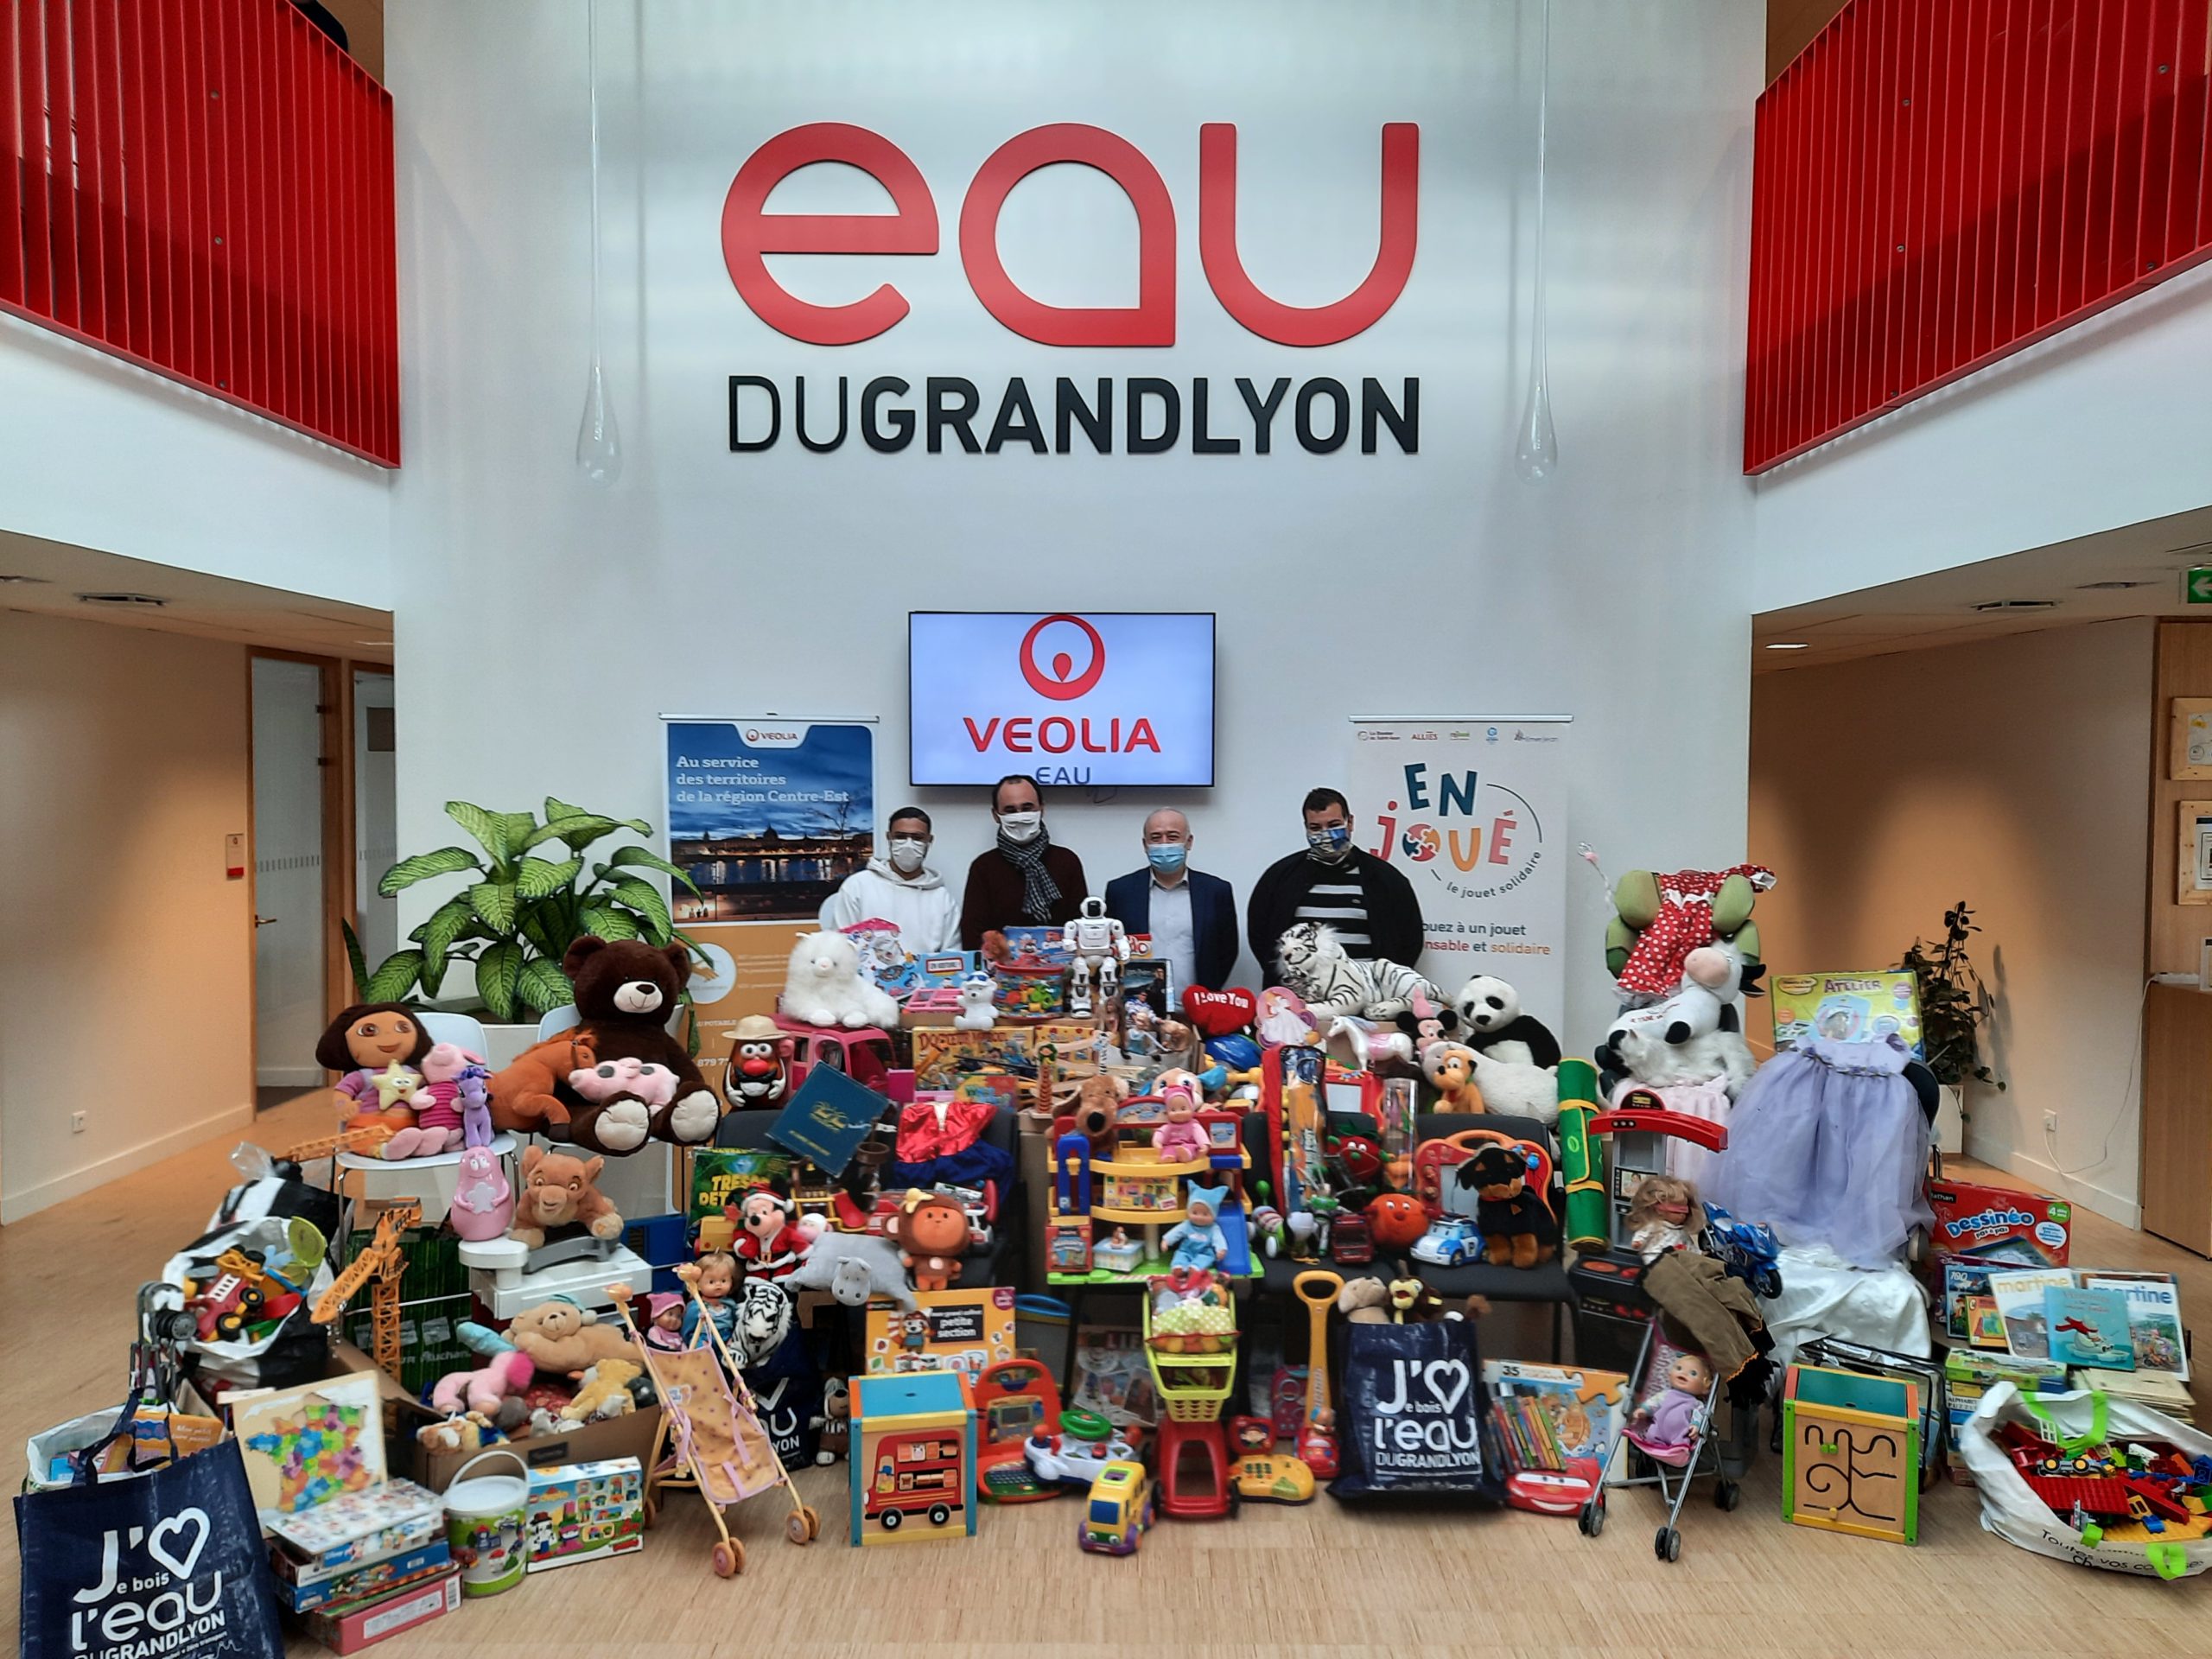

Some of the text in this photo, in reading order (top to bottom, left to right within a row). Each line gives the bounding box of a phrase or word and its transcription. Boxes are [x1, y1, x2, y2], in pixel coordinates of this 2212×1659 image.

[721, 122, 1419, 346] eau
[728, 376, 1419, 454] DUGRANDLYON
[760, 732, 798, 741] VEOLIA
[963, 716, 1161, 753] VEOLIA
[676, 756, 759, 769] Au service
[676, 773, 787, 786] des territoires
[1036, 766, 1091, 785] EAU
[676, 790, 850, 806] de la région Centre-Est
[1404, 763, 1478, 817] EN
[1446, 850, 1542, 899] le jouet solidaire
[1422, 920, 1527, 938] ouez à un jouet
[1425, 939, 1551, 955] nsable et solidaire
[2049, 1206, 2056, 1217] 4
[1946, 1207, 2034, 1238] Dessinéo
[1998, 1275, 2069, 1293] martine
[2093, 1286, 2173, 1305] rtine
[940, 1317, 974, 1329] petite
[938, 1327, 976, 1338] section
[1503, 1366, 1520, 1376] 35
[1375, 1452, 1482, 1468] DUGRANDLYON
[2100, 1558, 2128, 1569] vos
[132, 1571, 170, 1592] bois
